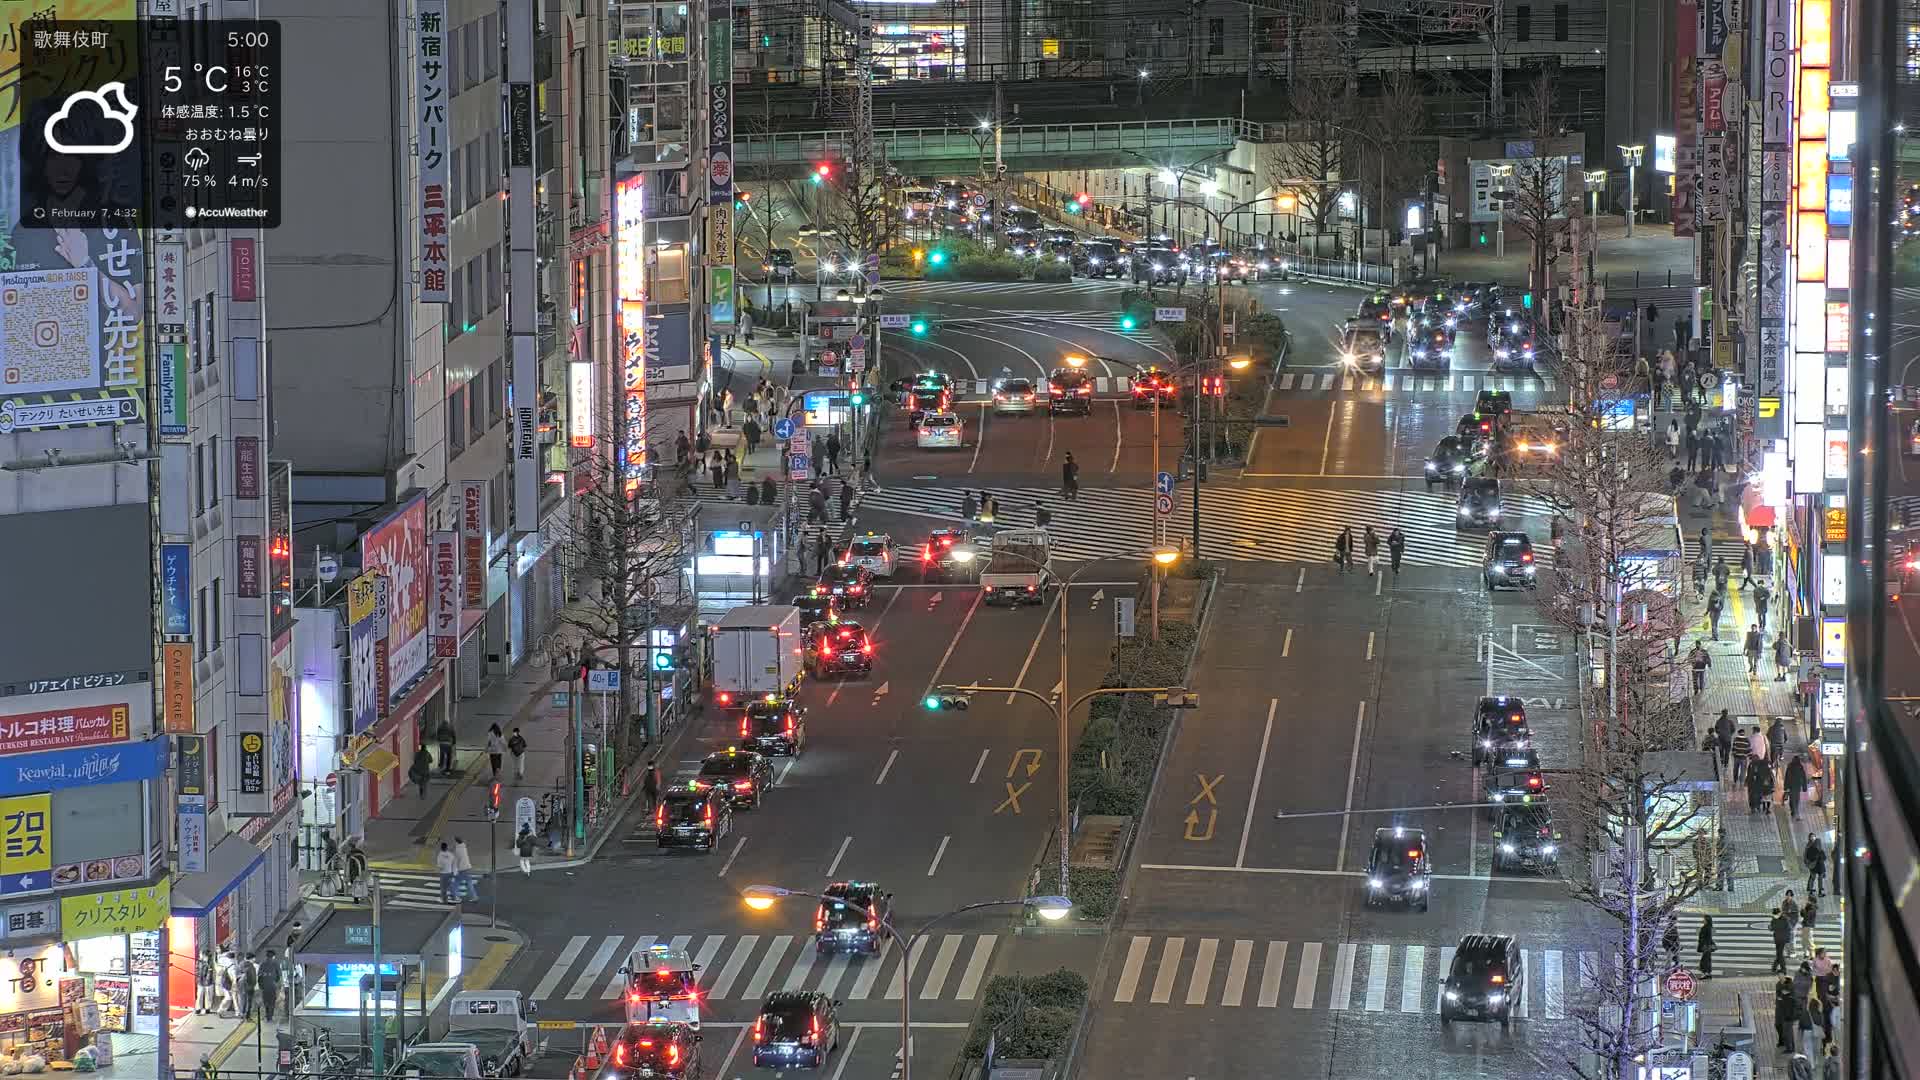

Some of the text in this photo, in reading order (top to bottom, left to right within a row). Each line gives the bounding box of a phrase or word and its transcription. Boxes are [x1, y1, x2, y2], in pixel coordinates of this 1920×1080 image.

[420, 11, 446, 292] 新宿サンパーク 三平本館
[713, 160, 728, 177] 薬
[716, 208, 728, 262] 肉汁水餃子
[164, 324, 180, 333] 3F
[1763, 330, 1777, 382] 大衆酒場
[161, 353, 173, 413] FamilyMart
[19, 404, 115, 423] テンクリ たいせい先生
[520, 407, 532, 460] HOMEGAME
[438, 543, 454, 629] 三平ストア
[378, 581, 386, 619] 389
[31, 735, 73, 746] RESTAURANT
[5, 811, 44, 834] プロ
[6, 835, 46, 858] ミス
[9, 912, 45, 932] 囲碁
[75, 903, 147, 928] クリスタル
